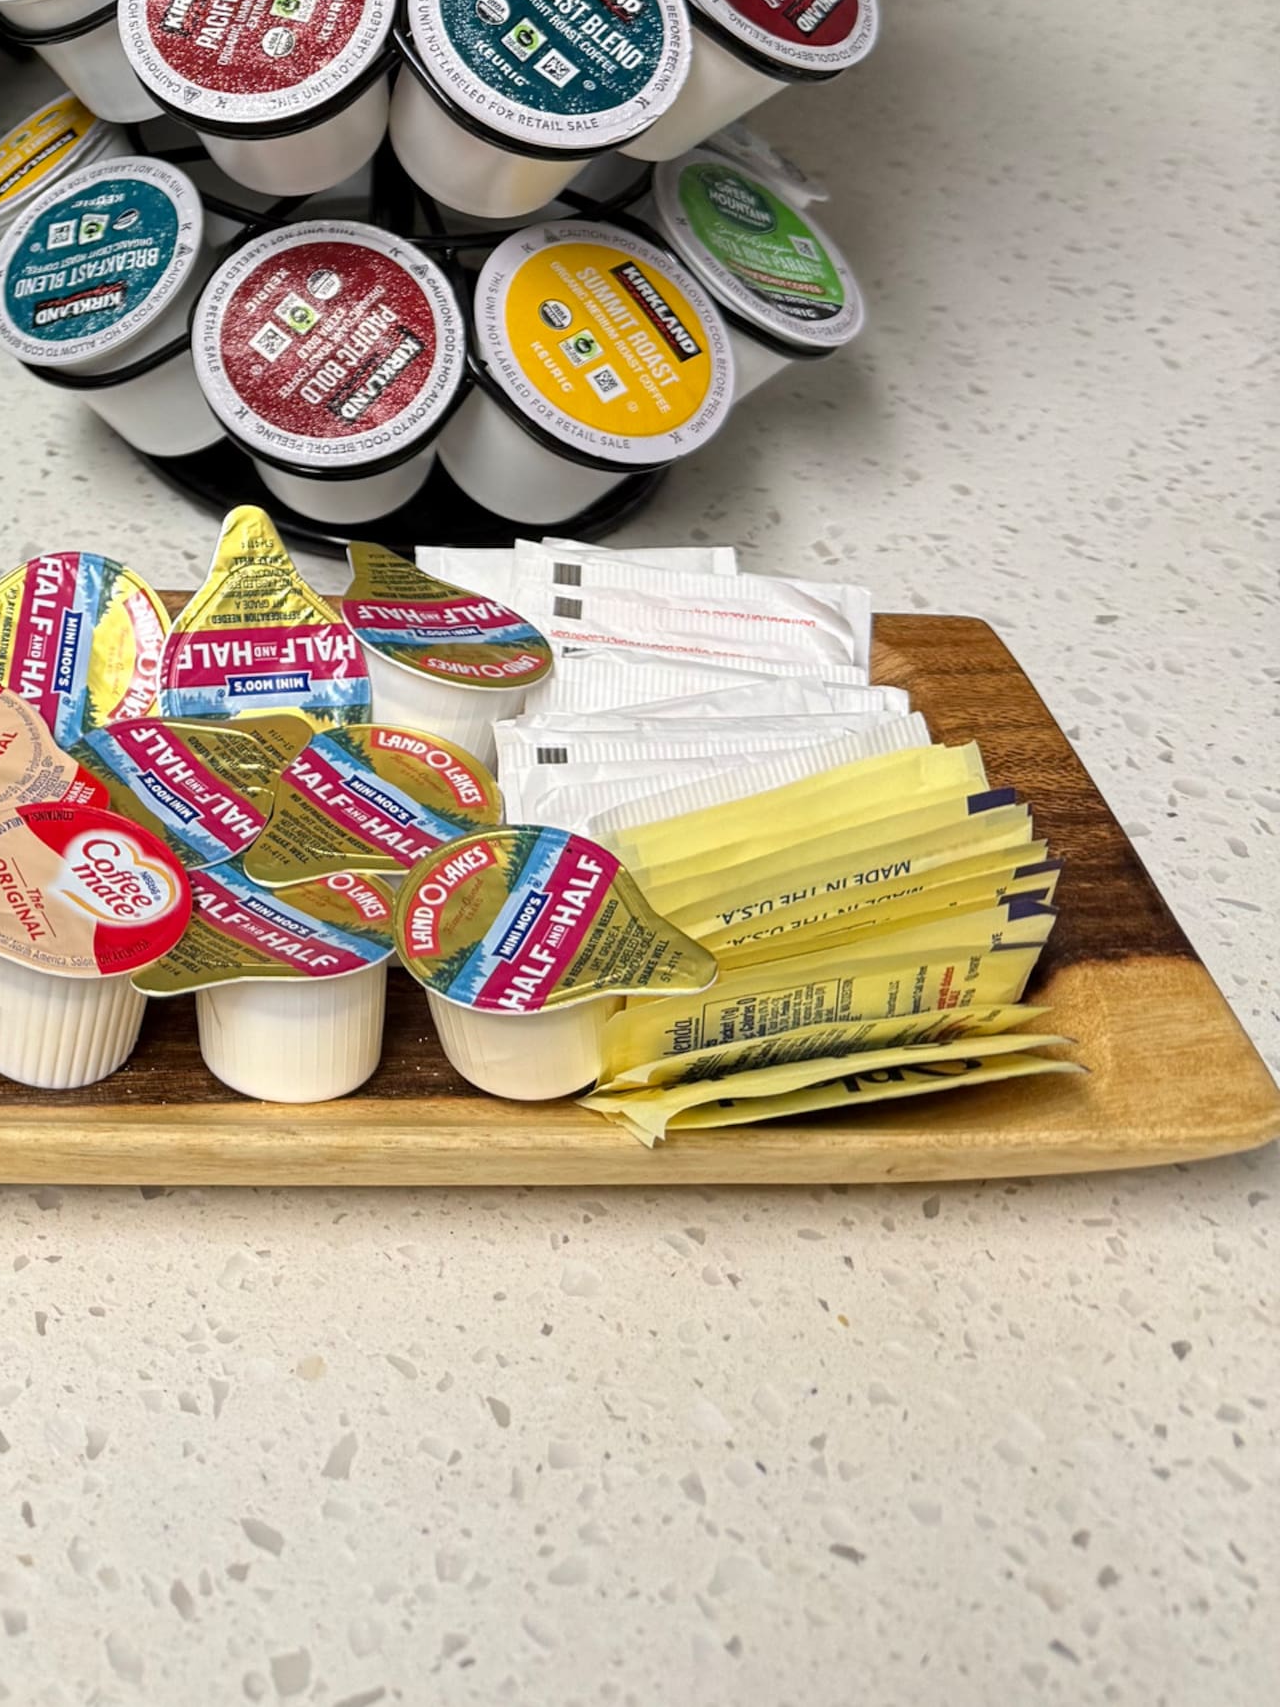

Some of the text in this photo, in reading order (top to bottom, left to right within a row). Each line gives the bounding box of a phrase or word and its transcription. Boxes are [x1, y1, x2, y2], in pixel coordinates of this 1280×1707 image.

[476, 39, 529, 87] KEURIG
[579, 42, 618, 75] COFFEE
[581, 14, 645, 71] BLEND
[517, 114, 600, 132] RETAIL SALE
[709, 190, 771, 222] MOUNTAIN
[714, 181, 755, 205] GREEN
[14, 248, 160, 298] BREAKFAST BLEND
[244, 267, 289, 314] KEURIG
[35, 291, 121, 325] KIRKLAND
[576, 266, 680, 388] SUMMIT ROAST
[622, 265, 699, 355] KIRKLAND
[300, 304, 397, 405] PACIFIC BOLD
[530, 341, 574, 393] KEURIG
[584, 301, 672, 415] MEDIUM ROAST COFFEE
[341, 339, 420, 419] KIRKLAND
[555, 415, 631, 450] RETAIL SALE
[30, 556, 63, 636] HALF
[356, 604, 420, 624] HALF
[443, 603, 520, 625] HALF
[57, 617, 78, 687] MINI MOO'S
[177, 632, 357, 670] HALF AND HALF
[427, 655, 541, 679] LAND O LAKES
[232, 676, 306, 693] MINI MOO'S
[130, 726, 187, 786] HALF
[377, 730, 427, 755] LAND
[425, 750, 449, 770] O
[442, 764, 483, 806] LAKES
[143, 773, 194, 819] MINI MOO'S
[202, 793, 262, 839] HALF
[289, 756, 349, 816] HALF
[342, 806, 374, 823] AND
[360, 812, 428, 859] HALF
[350, 780, 411, 821] MINI MOO'S
[71, 863, 134, 917] mate
[82, 839, 152, 908] Coffee
[443, 847, 489, 887] LAKES
[26, 887, 45, 911] The
[327, 872, 356, 892] O
[346, 880, 388, 919] LAKES
[419, 883, 448, 906] O
[715, 859, 912, 926] MADE IN THE U.S.A.
[192, 881, 242, 924] HALF
[240, 924, 267, 939] AND
[258, 931, 339, 968] HALF
[247, 901, 310, 937] MINI MOO'S
[412, 905, 435, 951] LAND
[498, 895, 542, 958] MINI MOO'S
[498, 854, 605, 1011] HALF AND HALF
